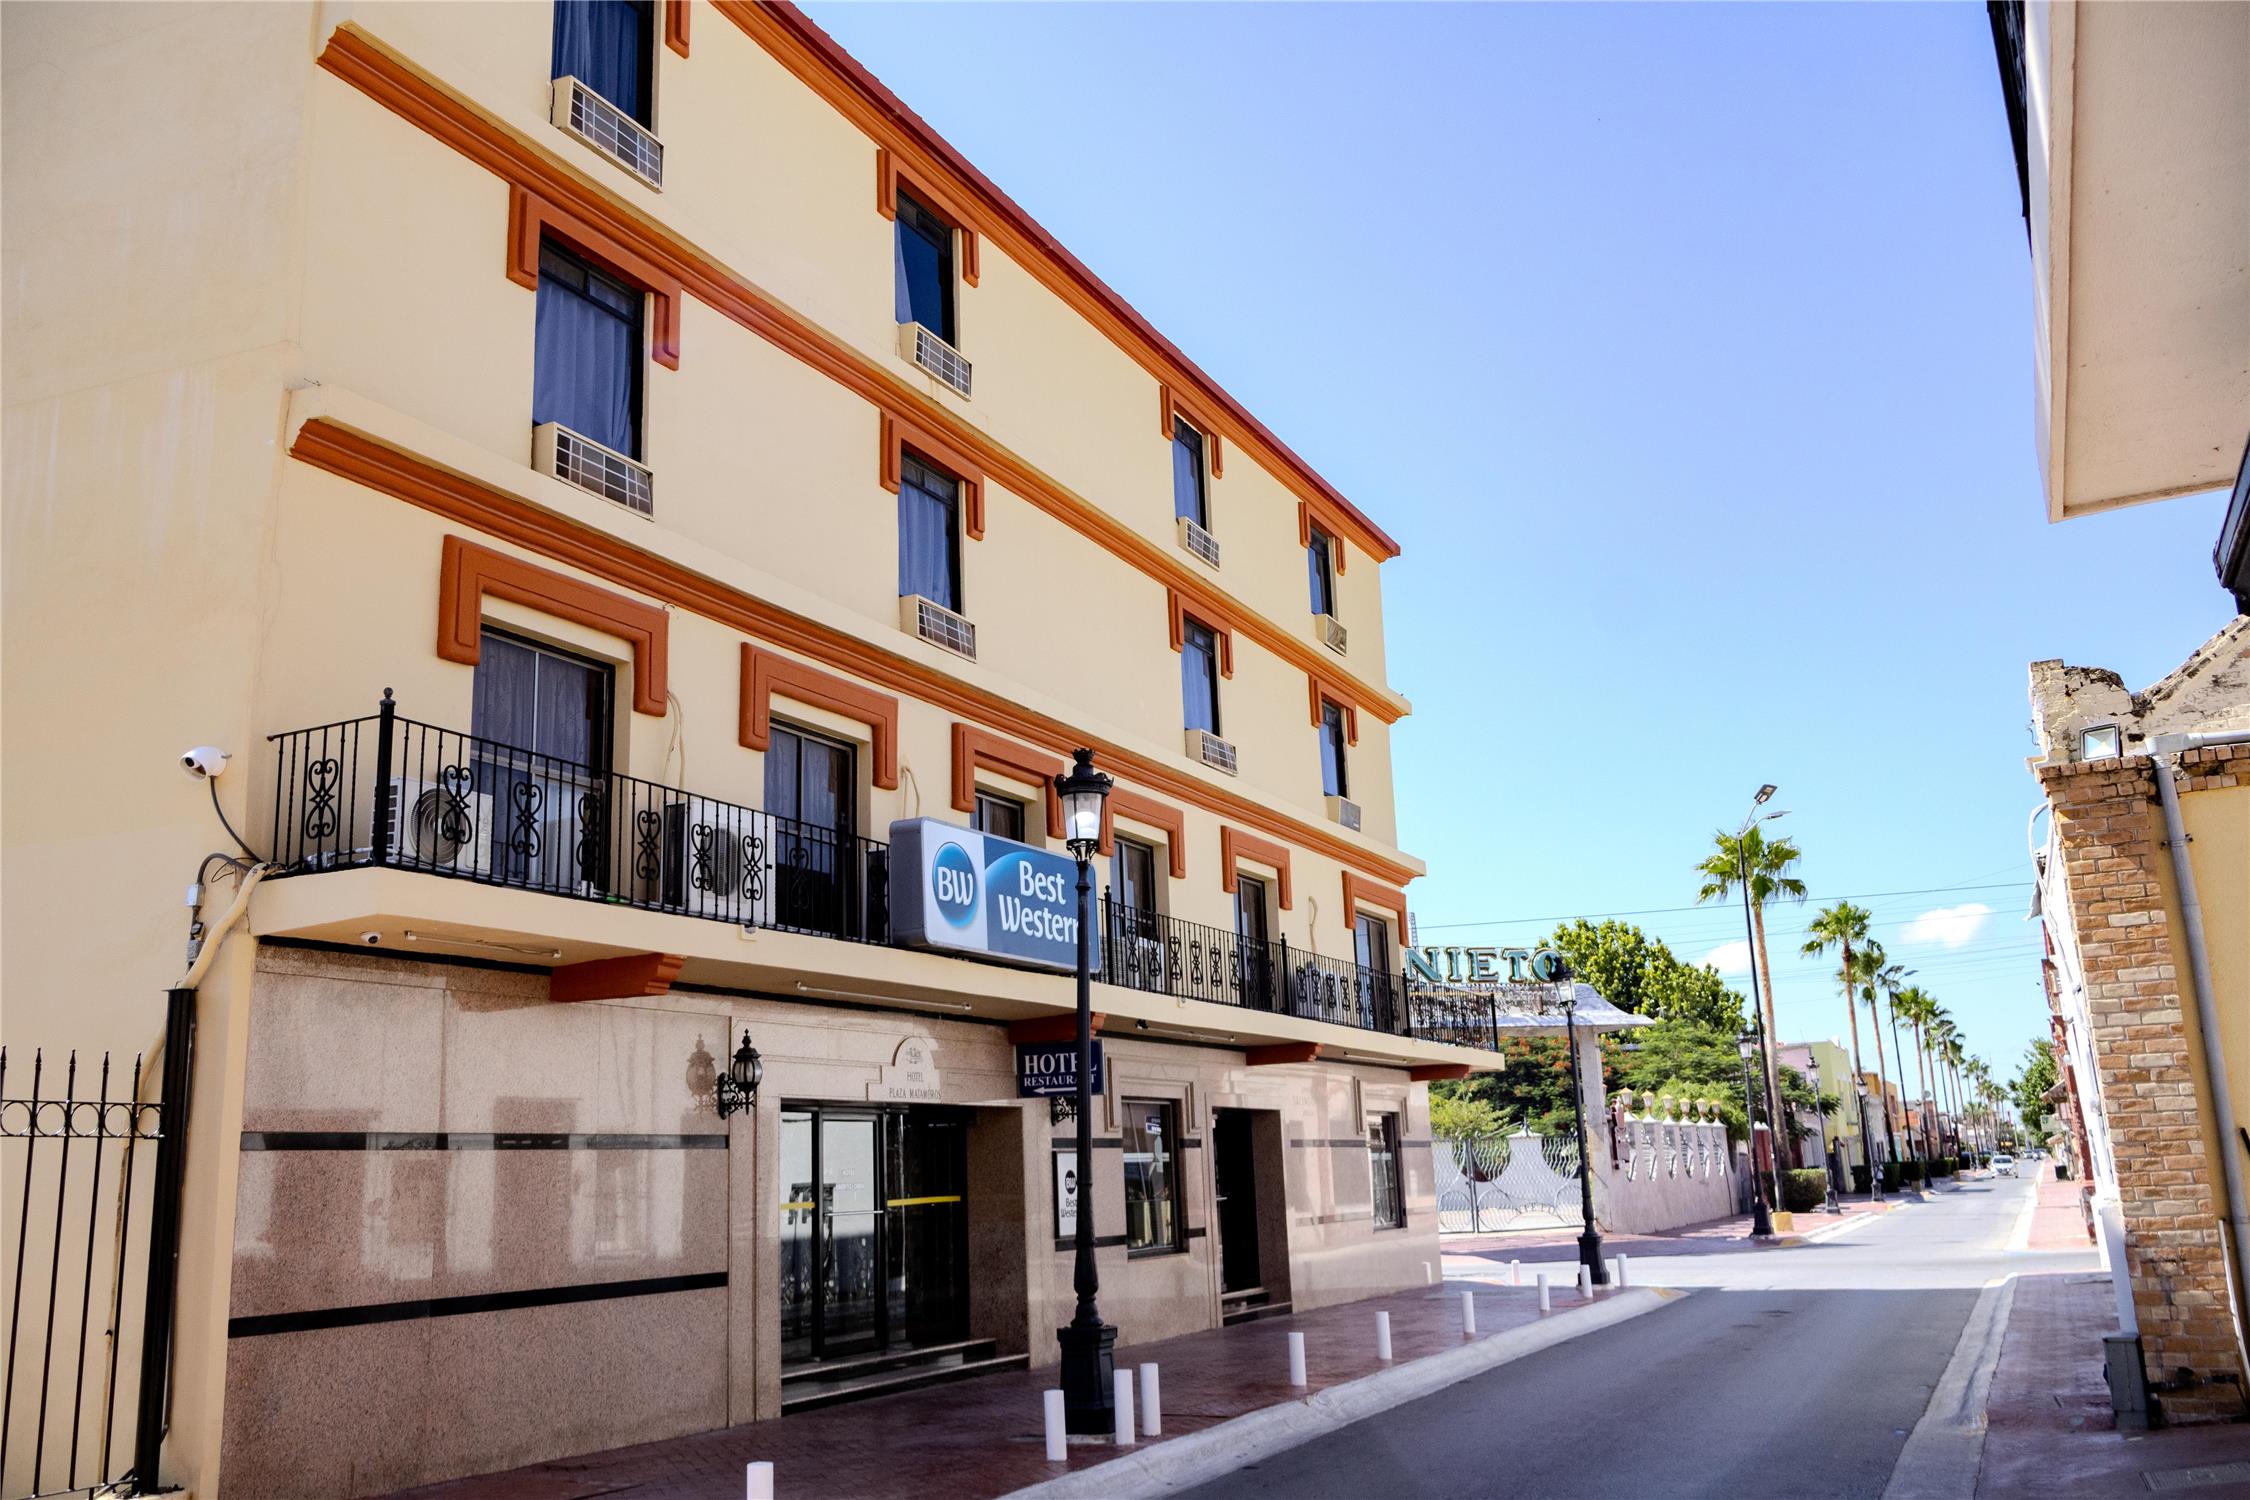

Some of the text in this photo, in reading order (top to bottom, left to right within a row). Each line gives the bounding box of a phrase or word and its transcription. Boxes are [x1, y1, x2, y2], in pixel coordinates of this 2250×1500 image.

[937, 866, 974, 907] BW
[1019, 860, 1067, 905] Best
[1405, 946, 1561, 984] NIETO
[906, 1071, 924, 1083] HOTEL
[1024, 1052, 1097, 1075] HOTE
[888, 1087, 906, 1098] PLAZA
